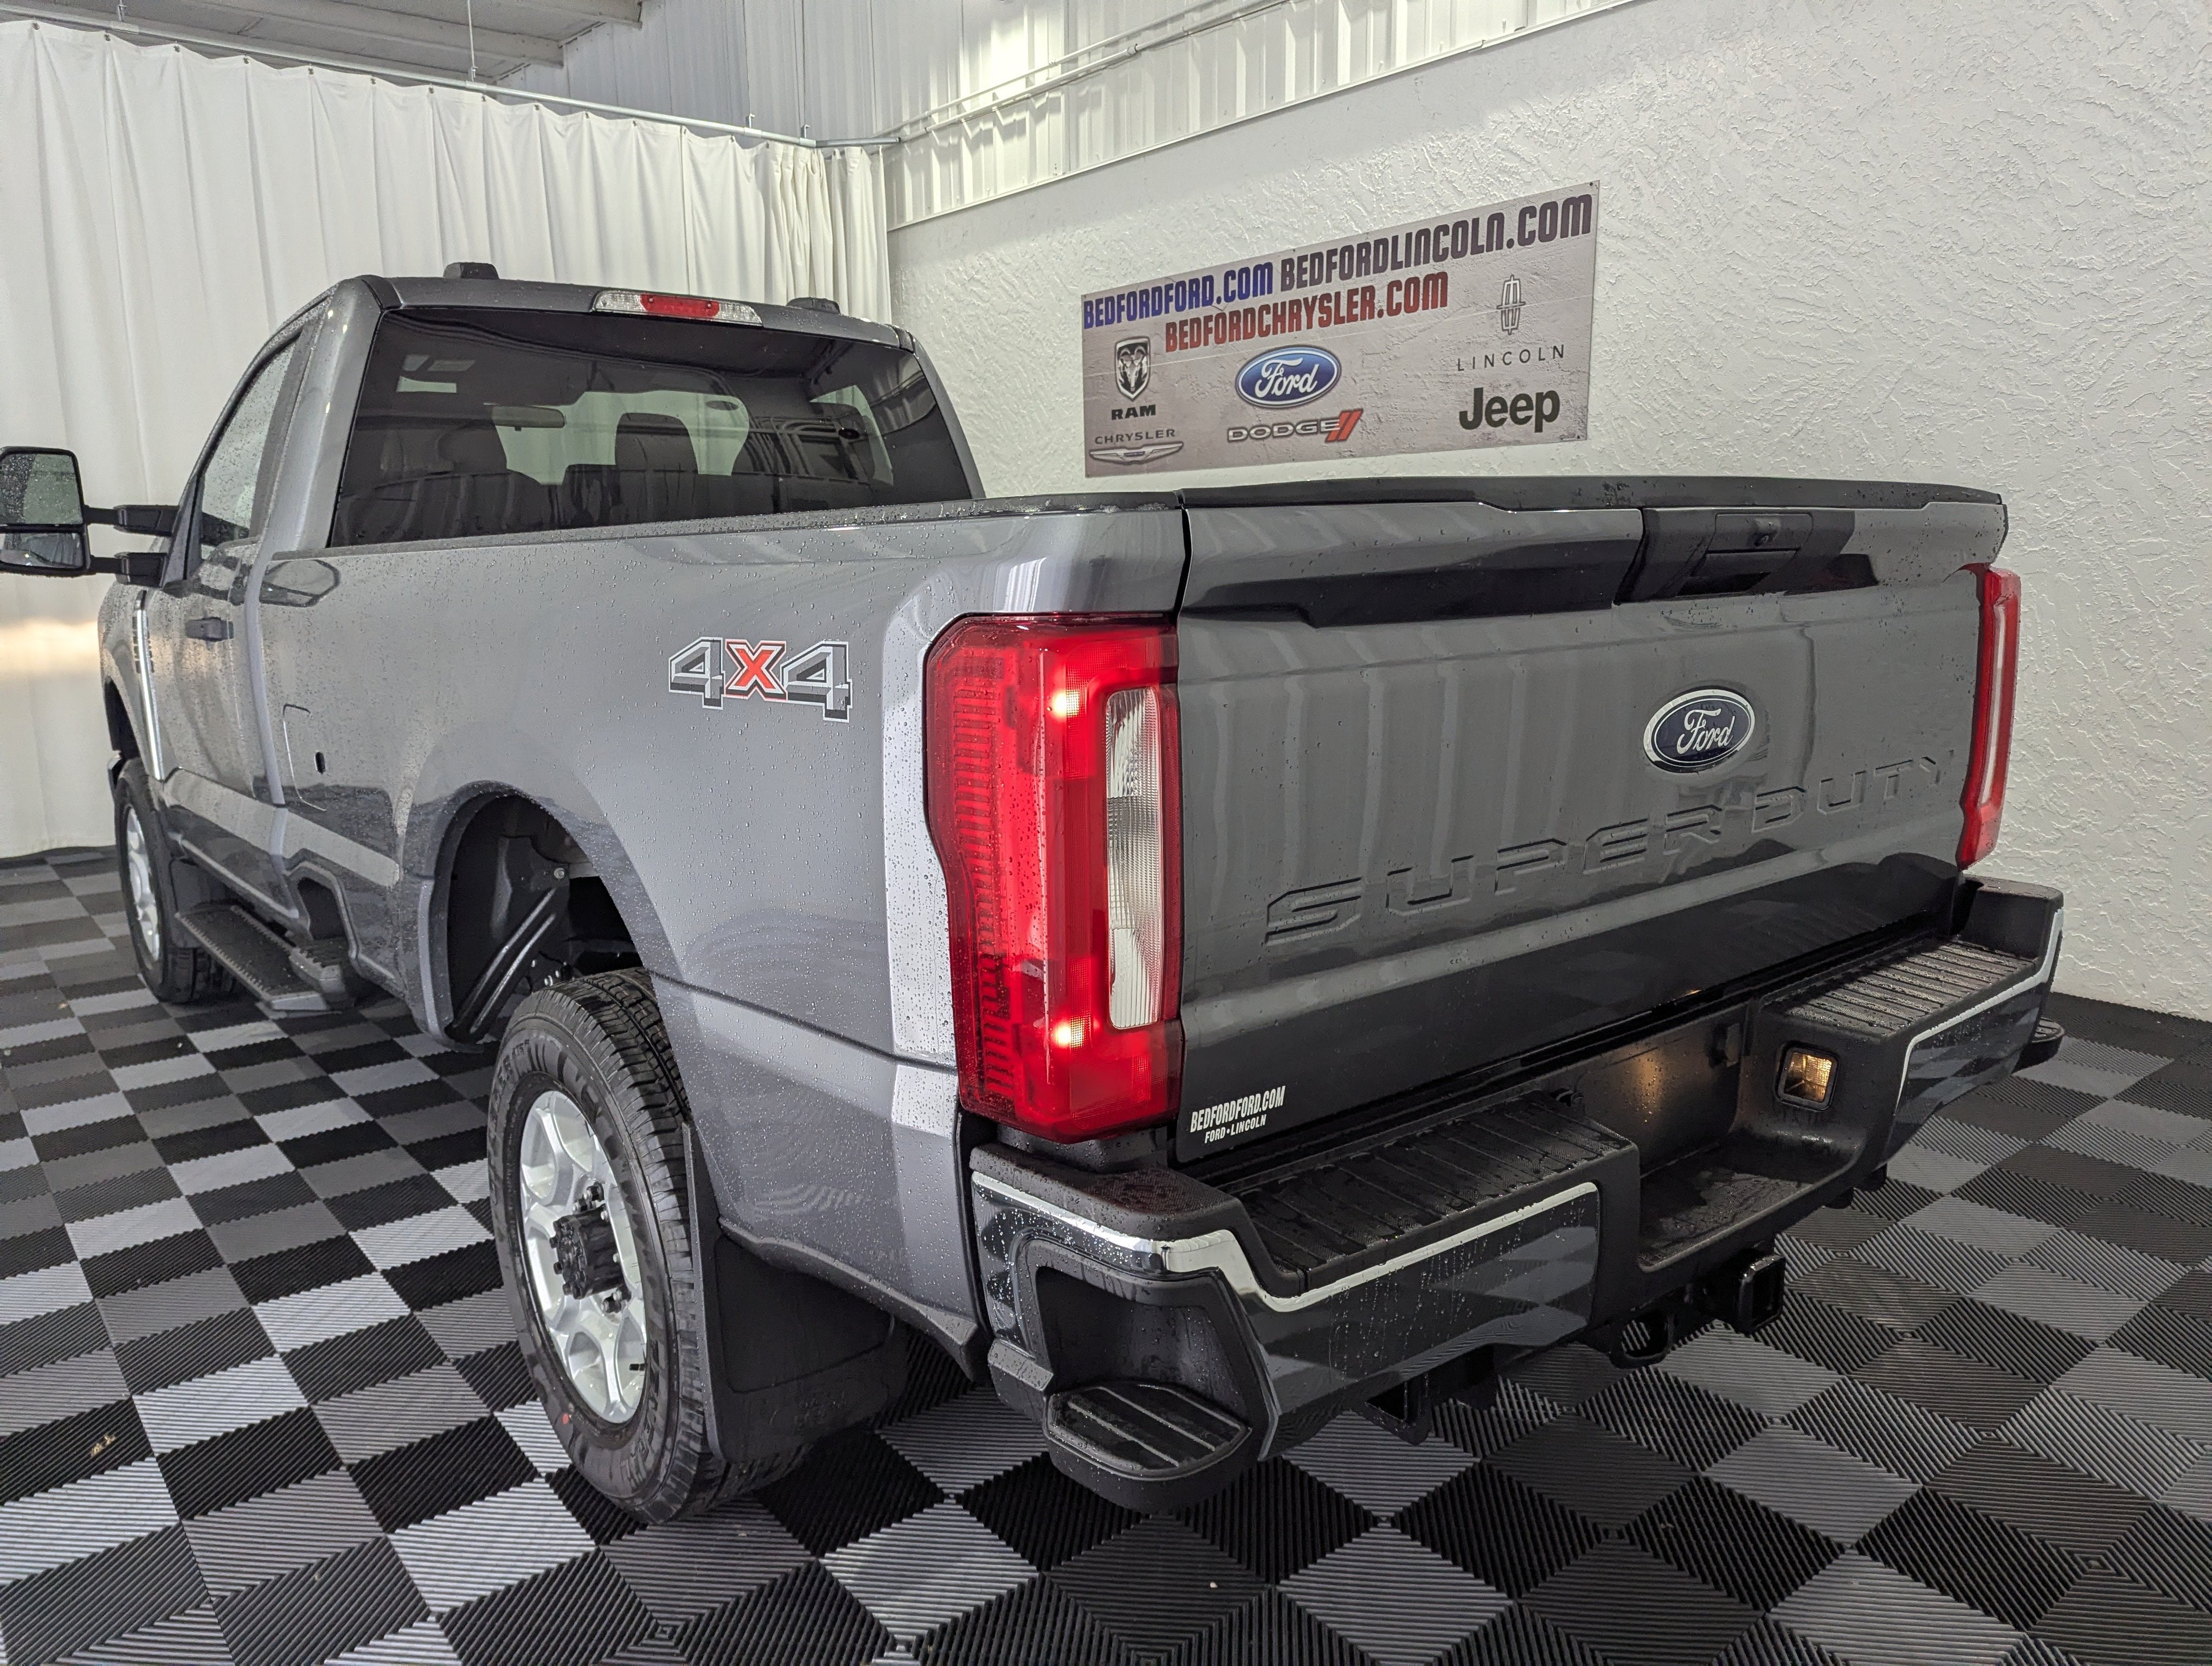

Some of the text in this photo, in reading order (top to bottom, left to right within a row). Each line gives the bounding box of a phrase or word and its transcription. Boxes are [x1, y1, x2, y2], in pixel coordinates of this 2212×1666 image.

[1084, 194, 1592, 329] BEDFORDFORD.COM BEDFORDLINCOLN.COM
[1166, 271, 1448, 353] BEDFORDCHRYSLER.COM
[1255, 357, 1320, 398] Ford
[1457, 344, 1564, 371] LINCOLN
[1111, 404, 1156, 420] RAM
[1228, 417, 1341, 442] DODGE
[1459, 387, 1560, 433] Jeep
[1095, 428, 1175, 445] CHRYSLER
[1677, 708, 1735, 754] Ford
[1263, 749, 1953, 947] SUPER DUTY
[1190, 1085, 1285, 1133] BEDFORDFORD.COM
